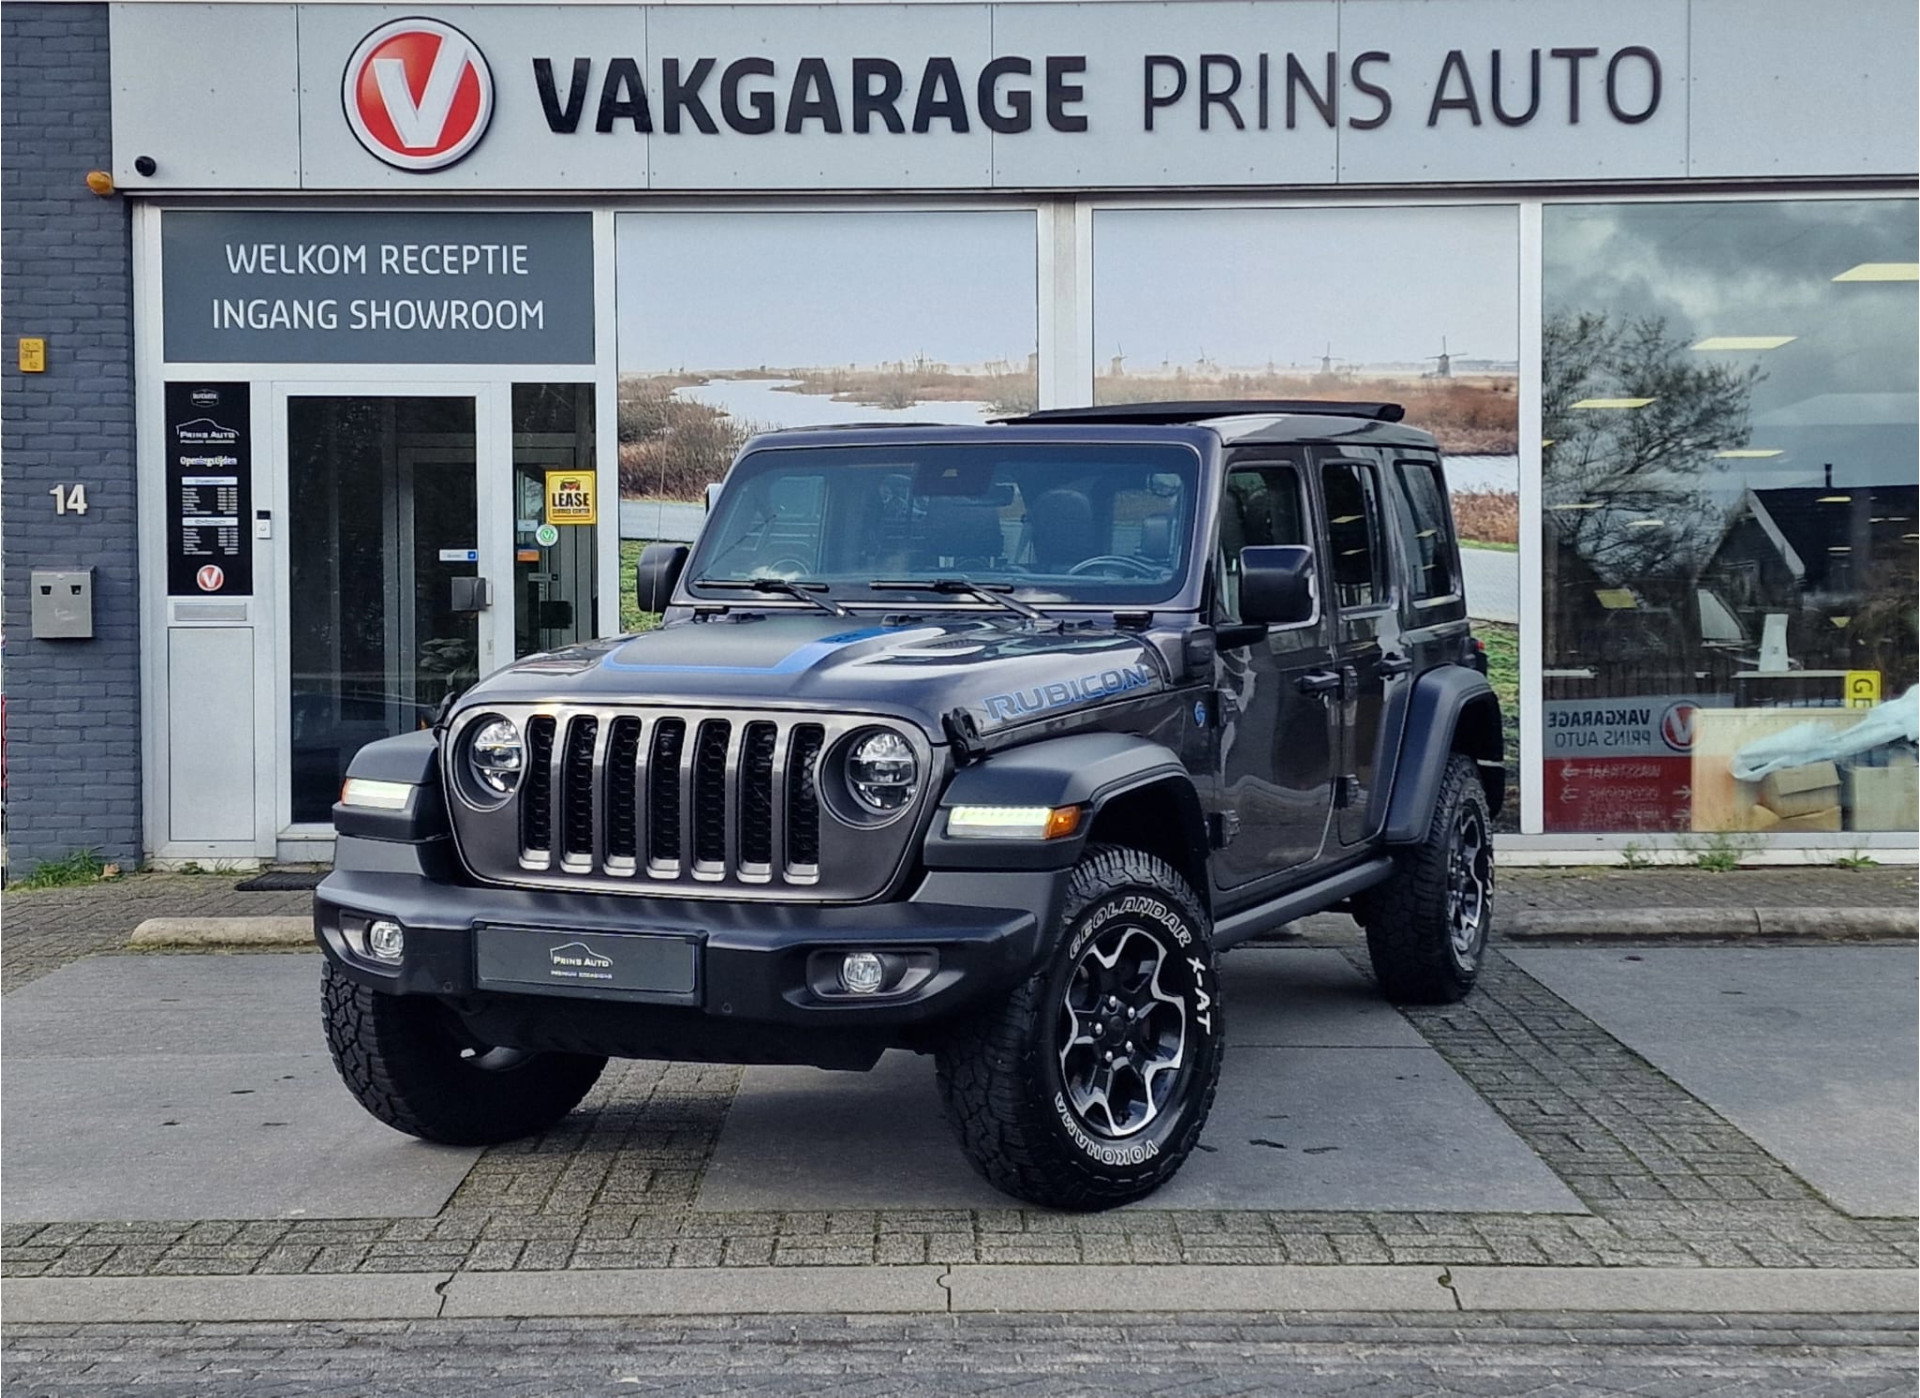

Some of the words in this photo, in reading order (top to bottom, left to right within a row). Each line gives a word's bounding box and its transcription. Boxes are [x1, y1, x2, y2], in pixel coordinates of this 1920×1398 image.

[531, 55, 1088, 135] VAKGARAGE
[1143, 50, 1392, 131] PRINS
[1427, 46, 1663, 127] AUTO
[225, 243, 367, 275] WELKOM
[380, 244, 529, 275] RECEPTIE
[212, 298, 338, 330] INGANG
[349, 299, 545, 330] SHOWROOM
[49, 484, 88, 516] 14
[551, 492, 590, 507] LEASE
[983, 664, 1148, 720] RUBICON
[553, 956, 582, 966] PRINS
[584, 958, 609, 967] AUTO
[1070, 896, 1193, 960] GEOLANDAR
[1186, 956, 1211, 1036] X-AT
[1055, 1090, 1159, 1166] YOKOHAMA
